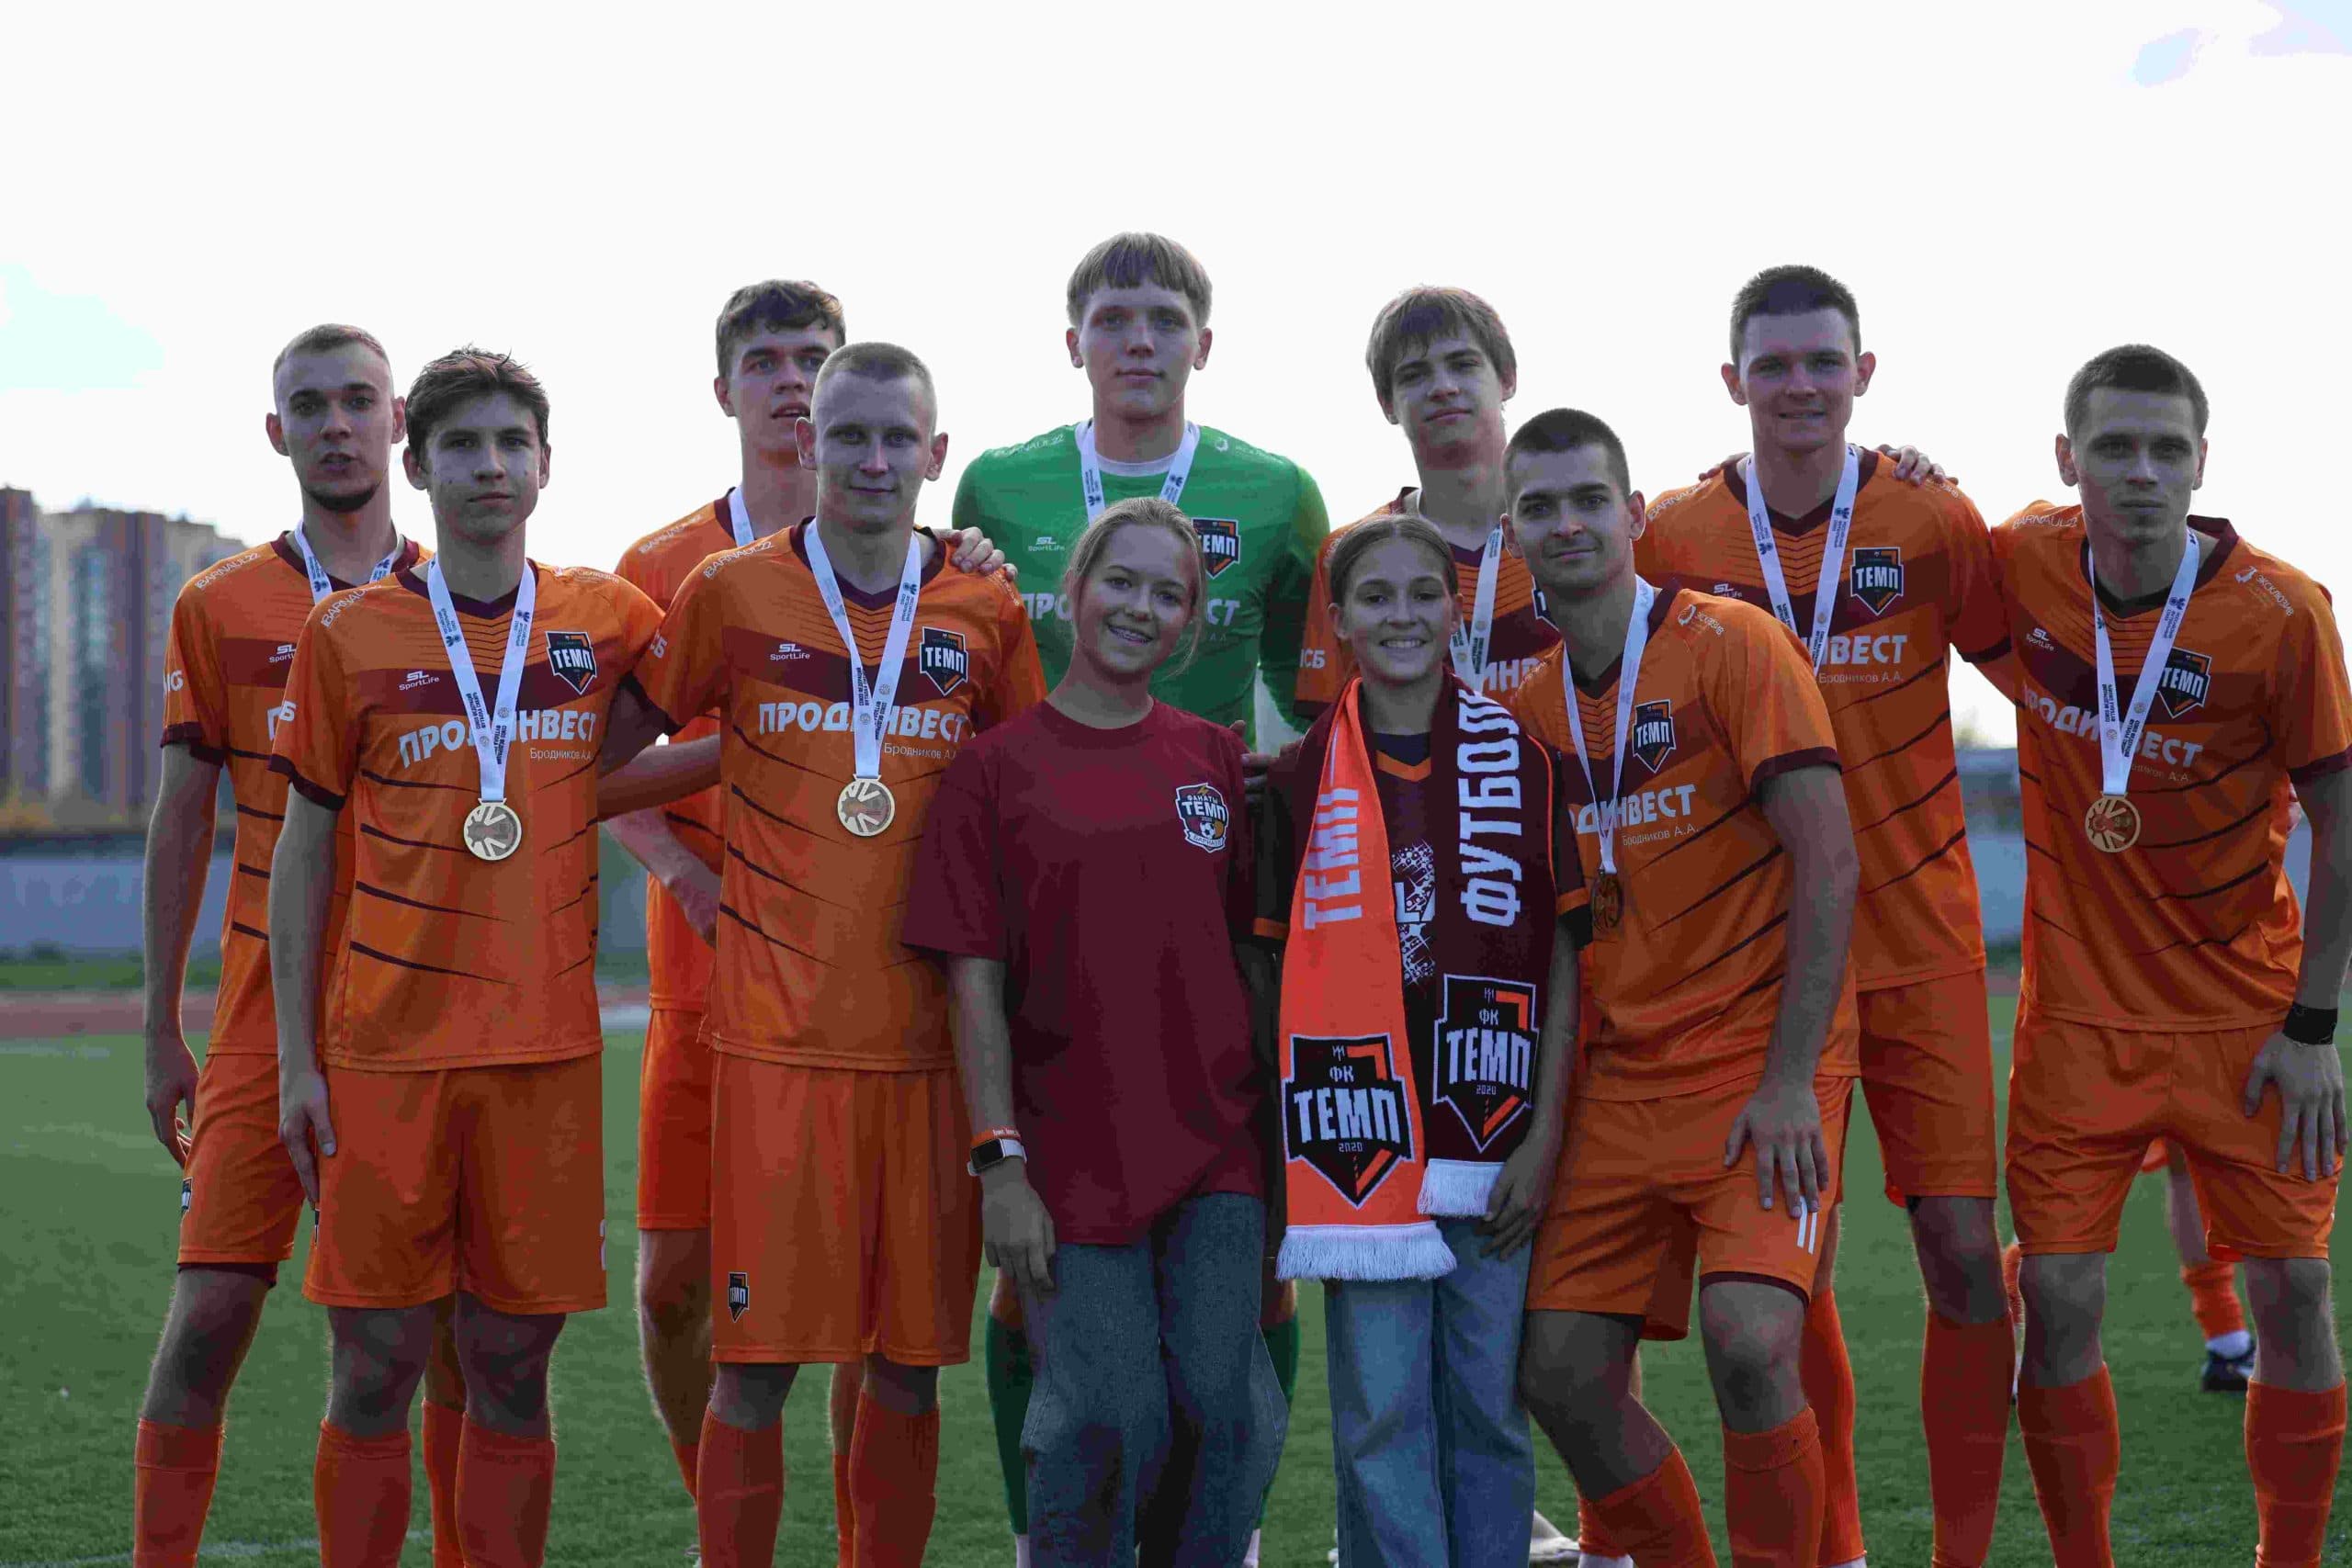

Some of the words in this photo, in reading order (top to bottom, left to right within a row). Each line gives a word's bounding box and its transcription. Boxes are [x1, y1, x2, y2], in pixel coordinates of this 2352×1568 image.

[1198, 534, 1236, 557] ЕМП
[1856, 566, 1898, 590] ТЕМП
[1713, 583, 1735, 593] SL
[2032, 627, 2050, 641] SL
[779, 643, 801, 652] SL
[269, 653, 296, 663] Sport
[552, 649, 593, 671] ТЕМП
[770, 652, 810, 661] SportLife
[924, 647, 965, 673] ТЕМП
[399, 675, 440, 690] SportLife
[406, 671, 430, 682] SL
[2161, 667, 2204, 699] ТЕМП
[1636, 721, 1669, 749] ТЕМП
[884, 742, 942, 760] Бродников
[1182, 800, 1227, 822] ТЕМП
[1623, 829, 1670, 846] Бродников
[1304, 788, 1363, 930] ТЕМП
[1479, 1008, 1499, 1025] ФК
[1446, 1028, 1532, 1089] ТЕМП
[1329, 1066, 1354, 1083] ФК
[1476, 1085, 1497, 1095] 2020
[1294, 1087, 1401, 1144] ТЕМП
[1339, 1143, 1363, 1152] 2020
